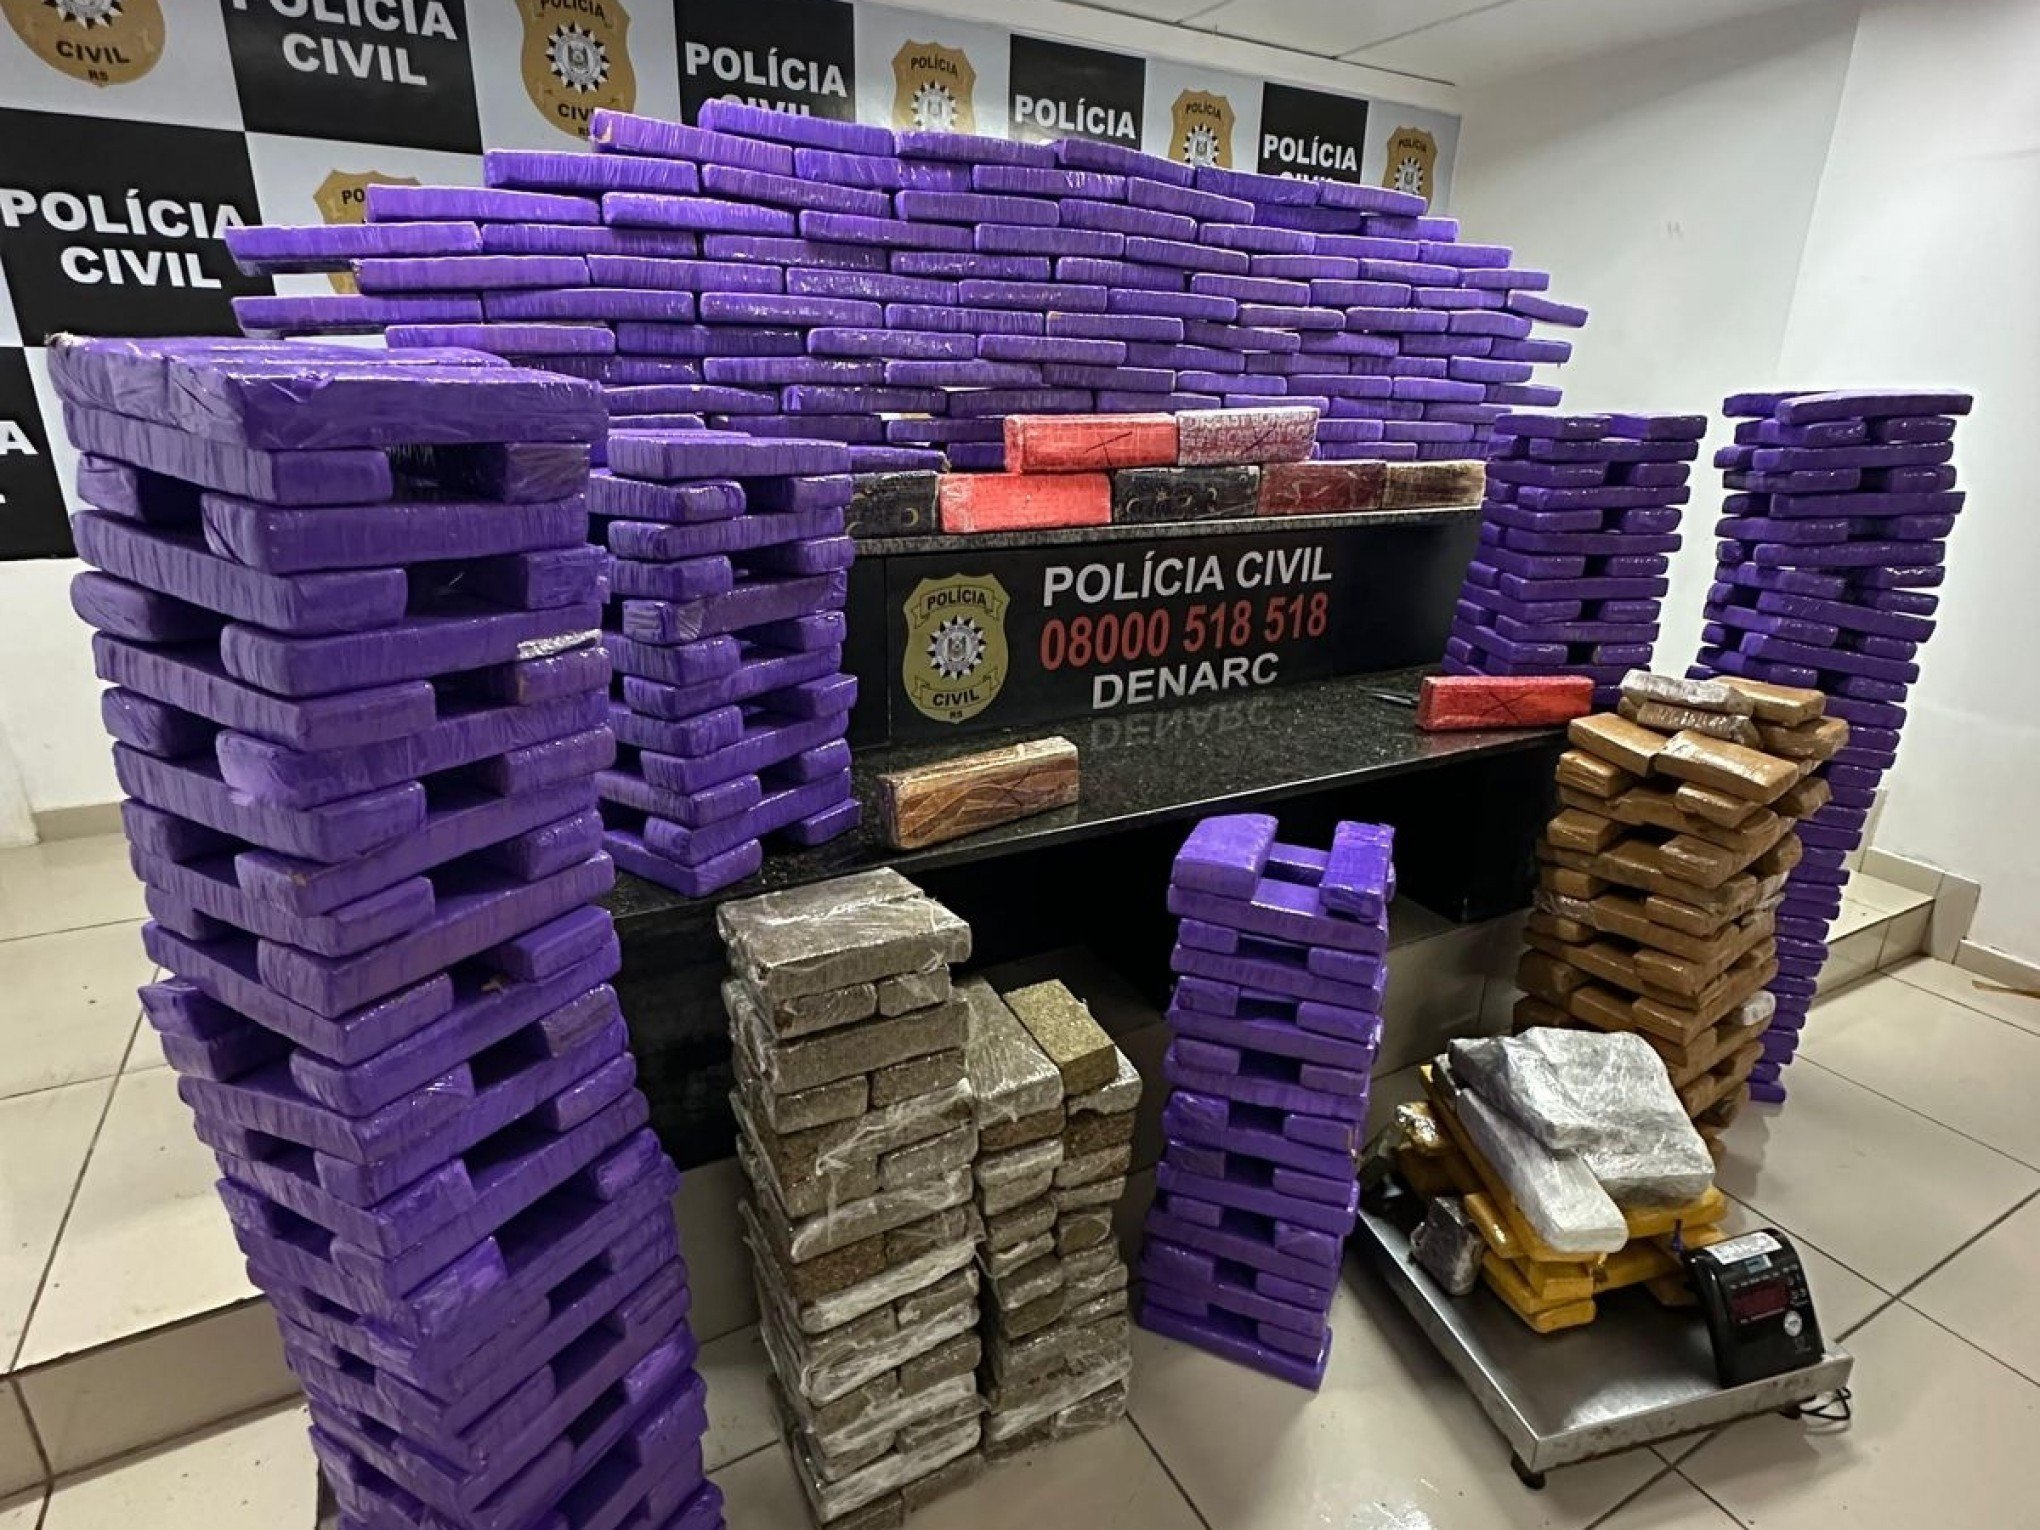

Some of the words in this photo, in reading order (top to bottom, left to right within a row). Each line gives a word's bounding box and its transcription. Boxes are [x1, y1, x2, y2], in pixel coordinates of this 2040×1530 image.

[56, 40, 131, 64] CIVIL
[282, 32, 428, 86] CIVIL
[685, 41, 847, 98] POLÍCIA
[910, 54, 958, 77] POLÍCIA
[88, 69, 109, 82] RS
[557, 103, 594, 121] CIV
[1015, 94, 1136, 140] POLÍCIA
[1185, 101, 1221, 121] POLÍCIA
[1262, 133, 1358, 171] POLÍCIA
[0, 187, 245, 239] POLÍCIA
[60, 247, 223, 290] CIVIL
[1043, 550, 1225, 607] POLÍCIA
[1236, 546, 1333, 586] CIVIL
[927, 587, 988, 610] POLÍCIA
[1040, 607, 1171, 672] 08000
[1183, 600, 1252, 654] 518
[1264, 592, 1329, 643] 518
[933, 688, 979, 706] CIVIL
[1093, 652, 1280, 710] DENARC
